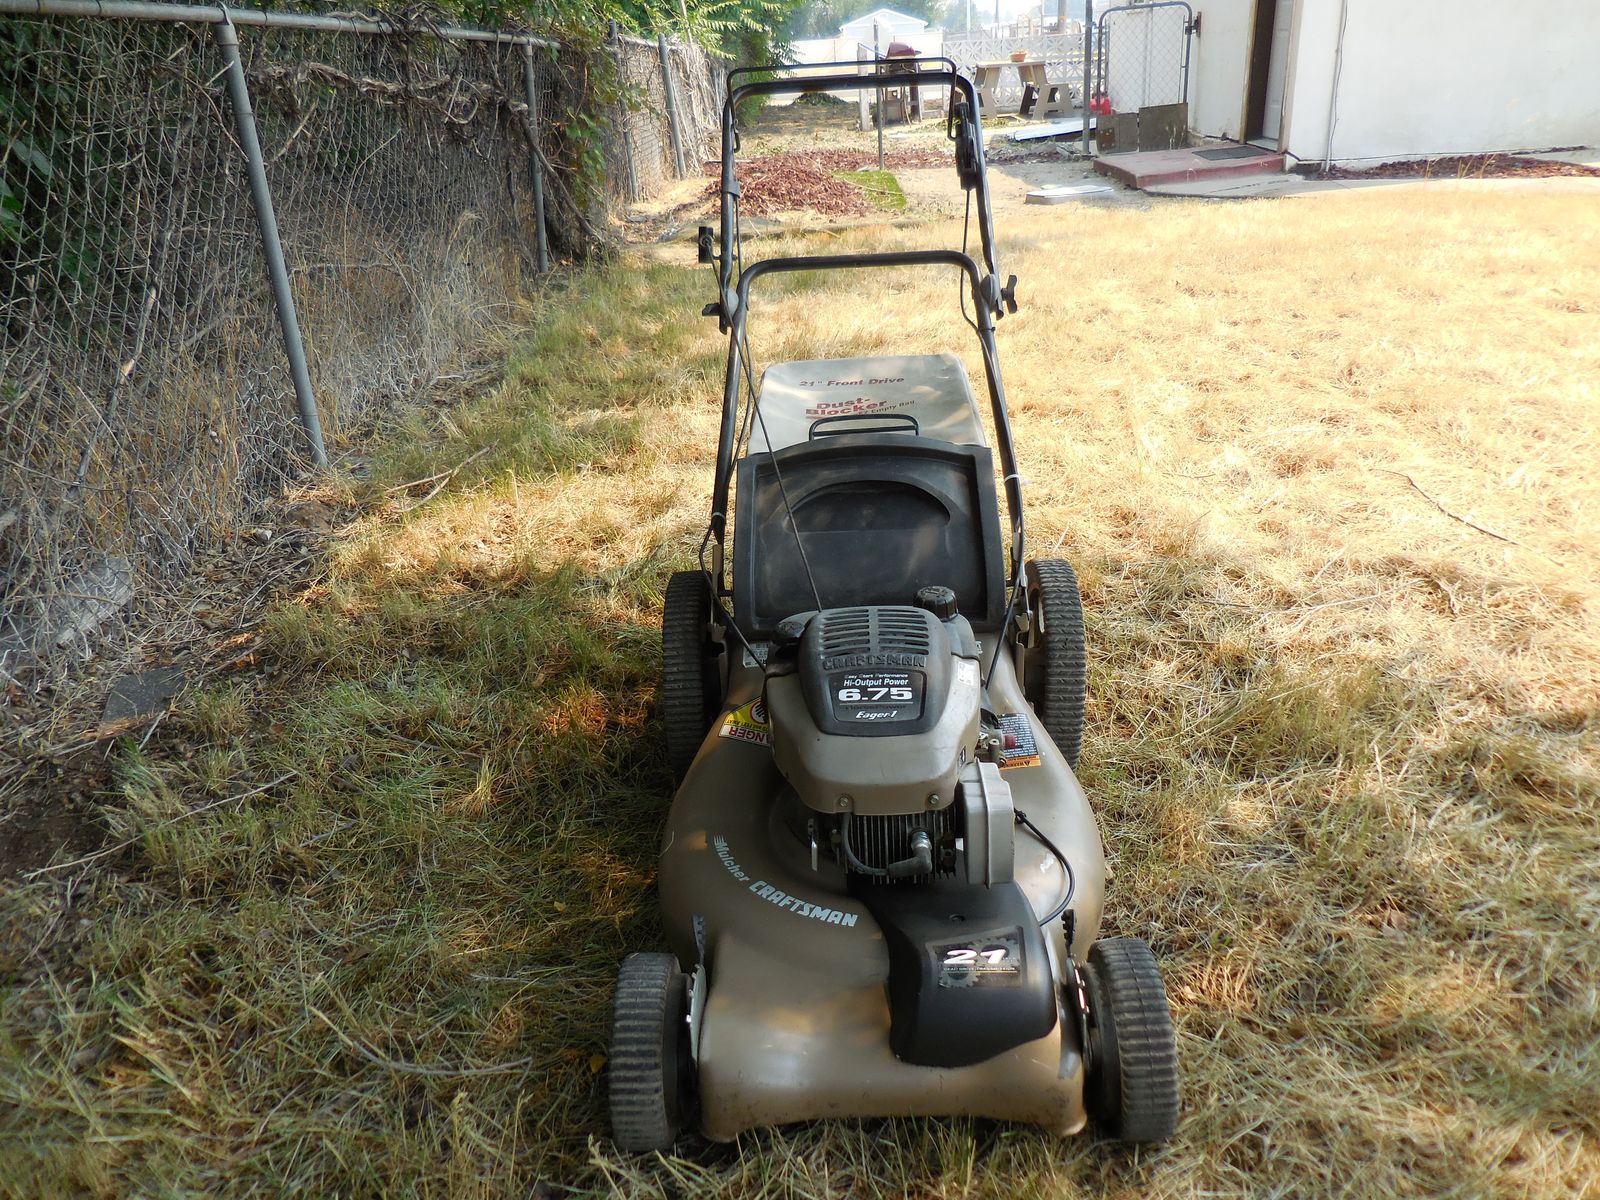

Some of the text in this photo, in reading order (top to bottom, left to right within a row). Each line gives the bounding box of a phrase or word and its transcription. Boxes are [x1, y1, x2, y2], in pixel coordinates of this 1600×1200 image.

[806, 400, 887, 416] Blocker
[816, 397, 871, 409] Dust-
[823, 654, 927, 671] CRAFTSMAN
[843, 678, 882, 687] Hi-Output
[838, 687, 913, 701] 6.75
[729, 726, 769, 744] NGER
[714, 836, 858, 927] Mulcher CRAFTSMAN
[943, 949, 1006, 964] 21
